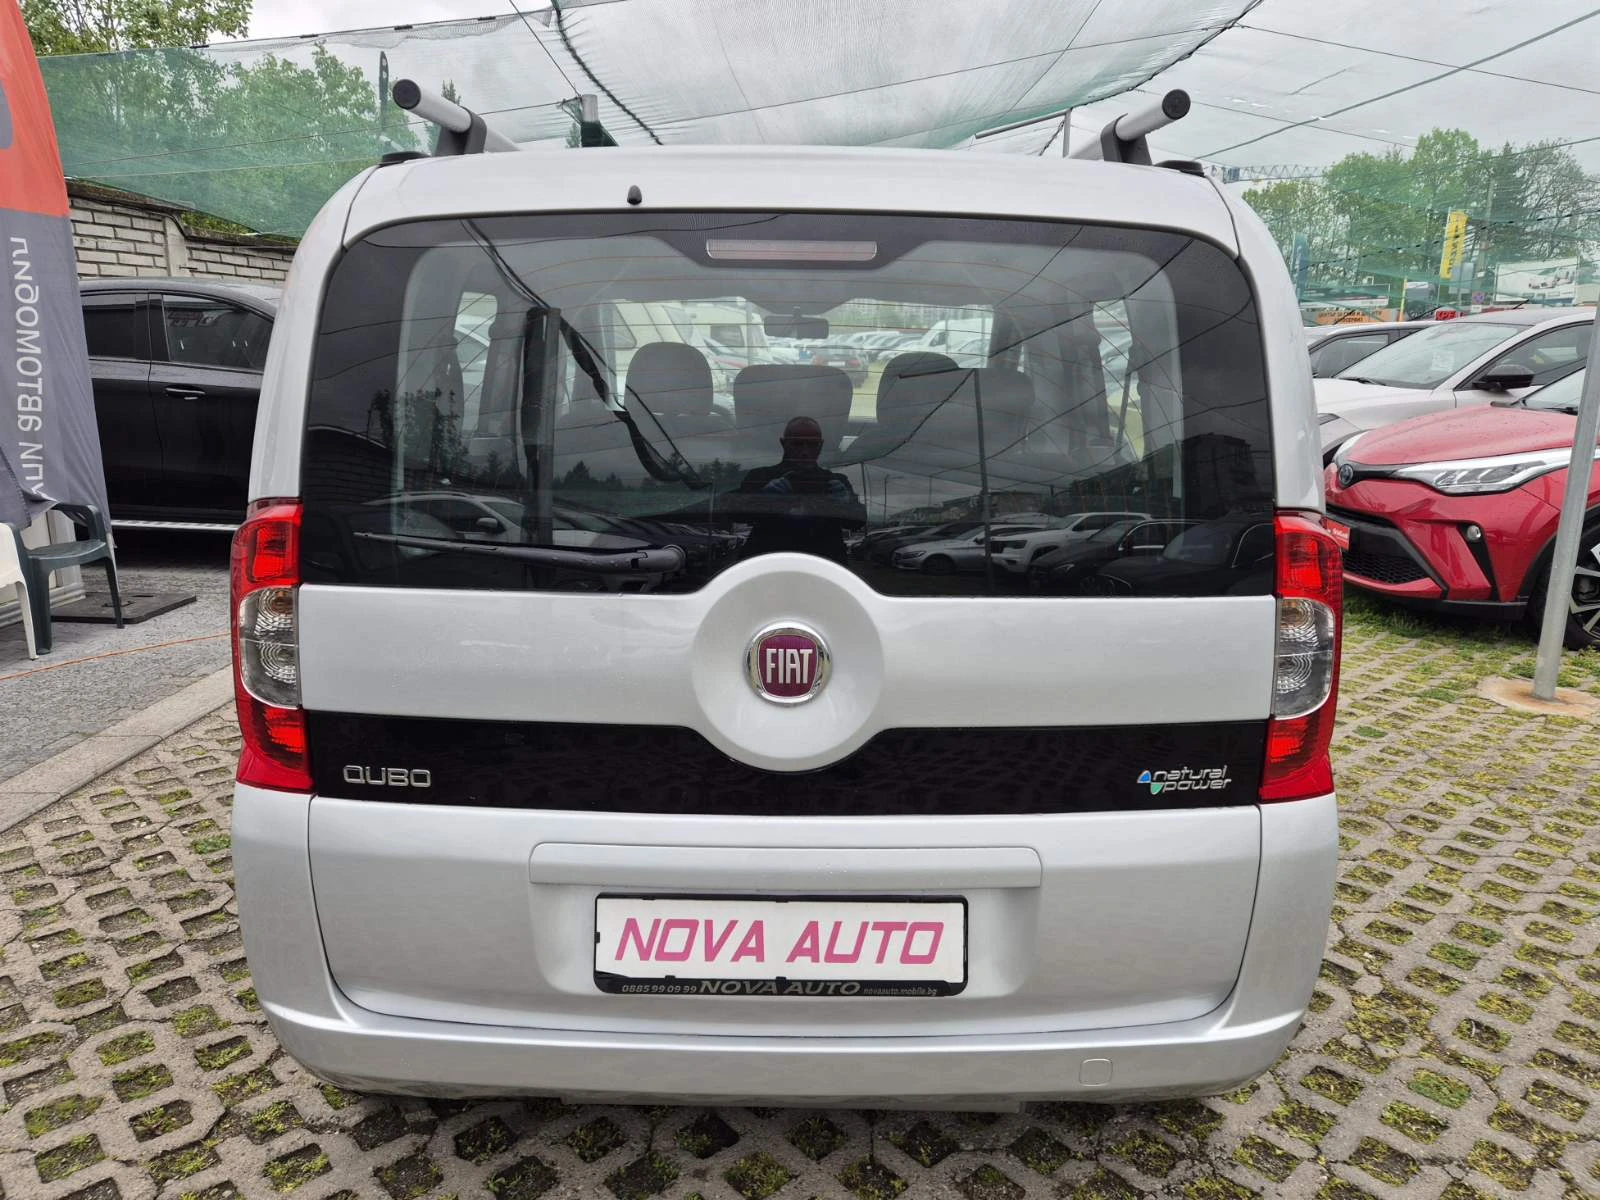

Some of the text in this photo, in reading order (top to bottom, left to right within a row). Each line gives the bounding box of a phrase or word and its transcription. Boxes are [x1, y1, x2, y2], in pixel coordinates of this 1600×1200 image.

[765, 648, 813, 684] FIAT
[342, 764, 432, 788] QUBO
[1153, 765, 1227, 780] natural
[1162, 779, 1232, 792] power
[614, 917, 945, 965] NOVA AUTO
[700, 980, 778, 994] NOVA
[783, 981, 861, 995] AUTO
